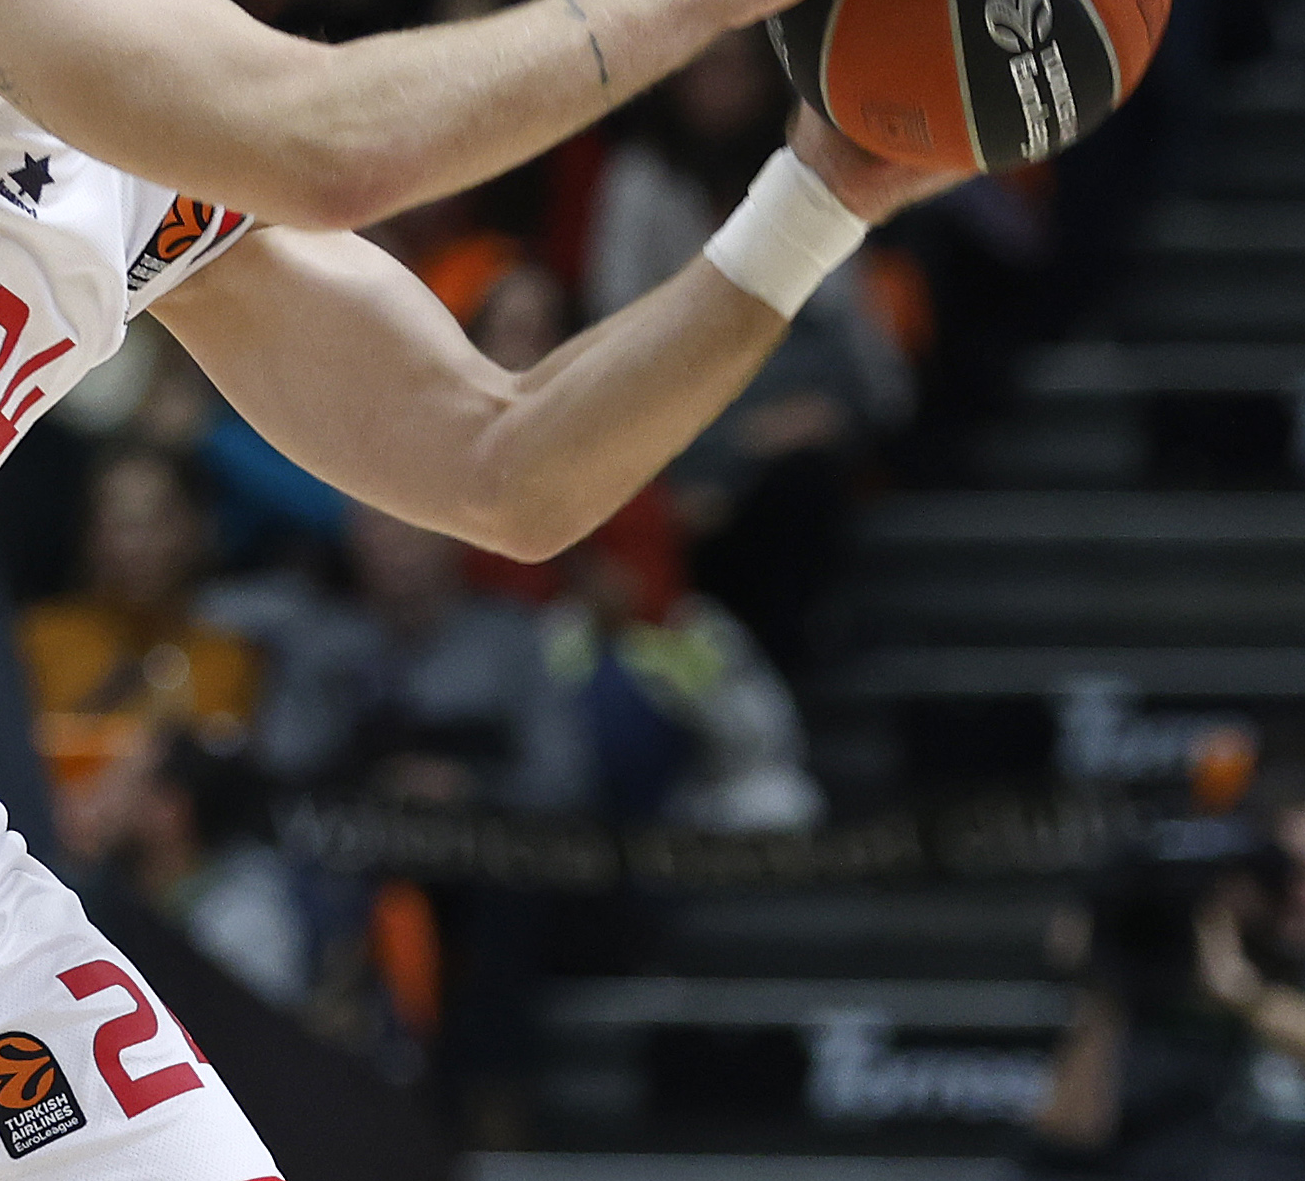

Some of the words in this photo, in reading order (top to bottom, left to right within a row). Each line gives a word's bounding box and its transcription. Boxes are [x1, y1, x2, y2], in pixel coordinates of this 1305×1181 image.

[56, 959, 211, 1119] 2
[4, 1092, 69, 1132] TURKISH
[10, 1104, 75, 1144] AIRLINES
[13, 1116, 80, 1153] EuroLeague
